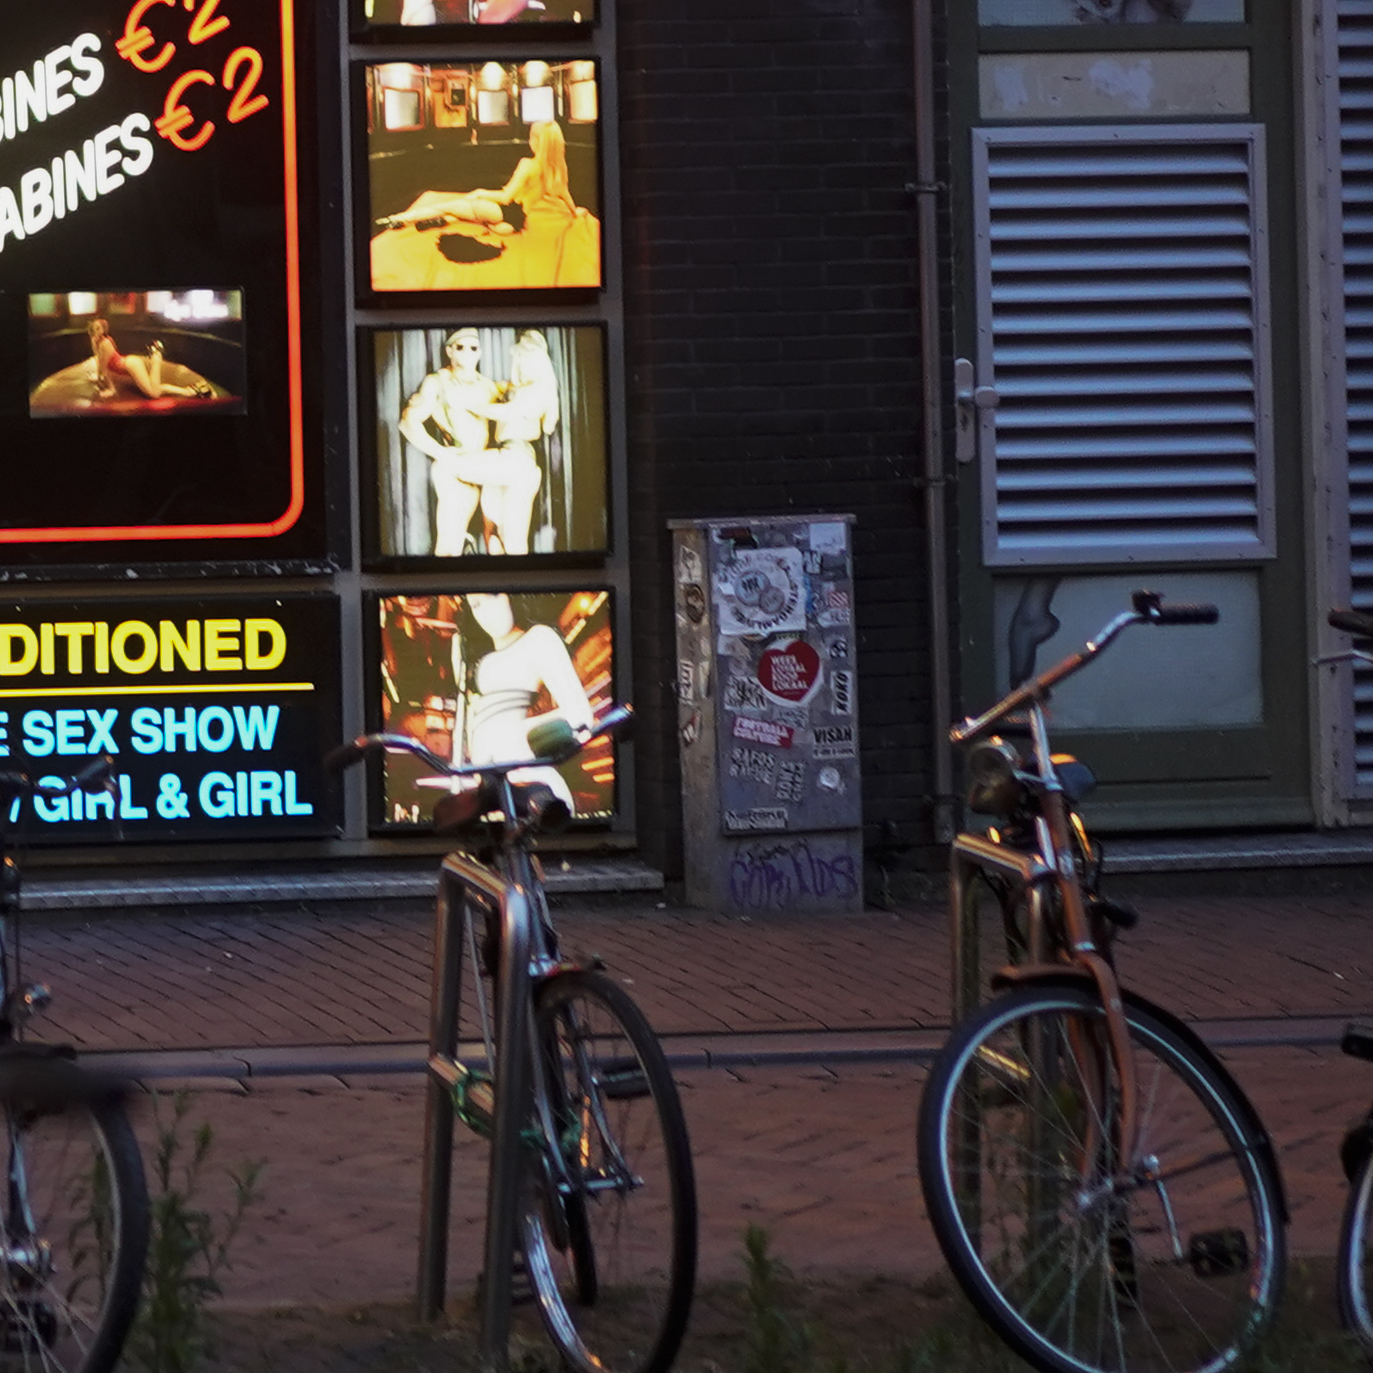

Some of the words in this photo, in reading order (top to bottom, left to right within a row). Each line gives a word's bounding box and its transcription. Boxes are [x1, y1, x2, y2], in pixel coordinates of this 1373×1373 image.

[836, 672, 849, 713] KOKO
[22, 708, 120, 756] SEX
[130, 705, 281, 754] SHOW
[156, 773, 191, 820] &
[198, 769, 314, 820] GIRL
